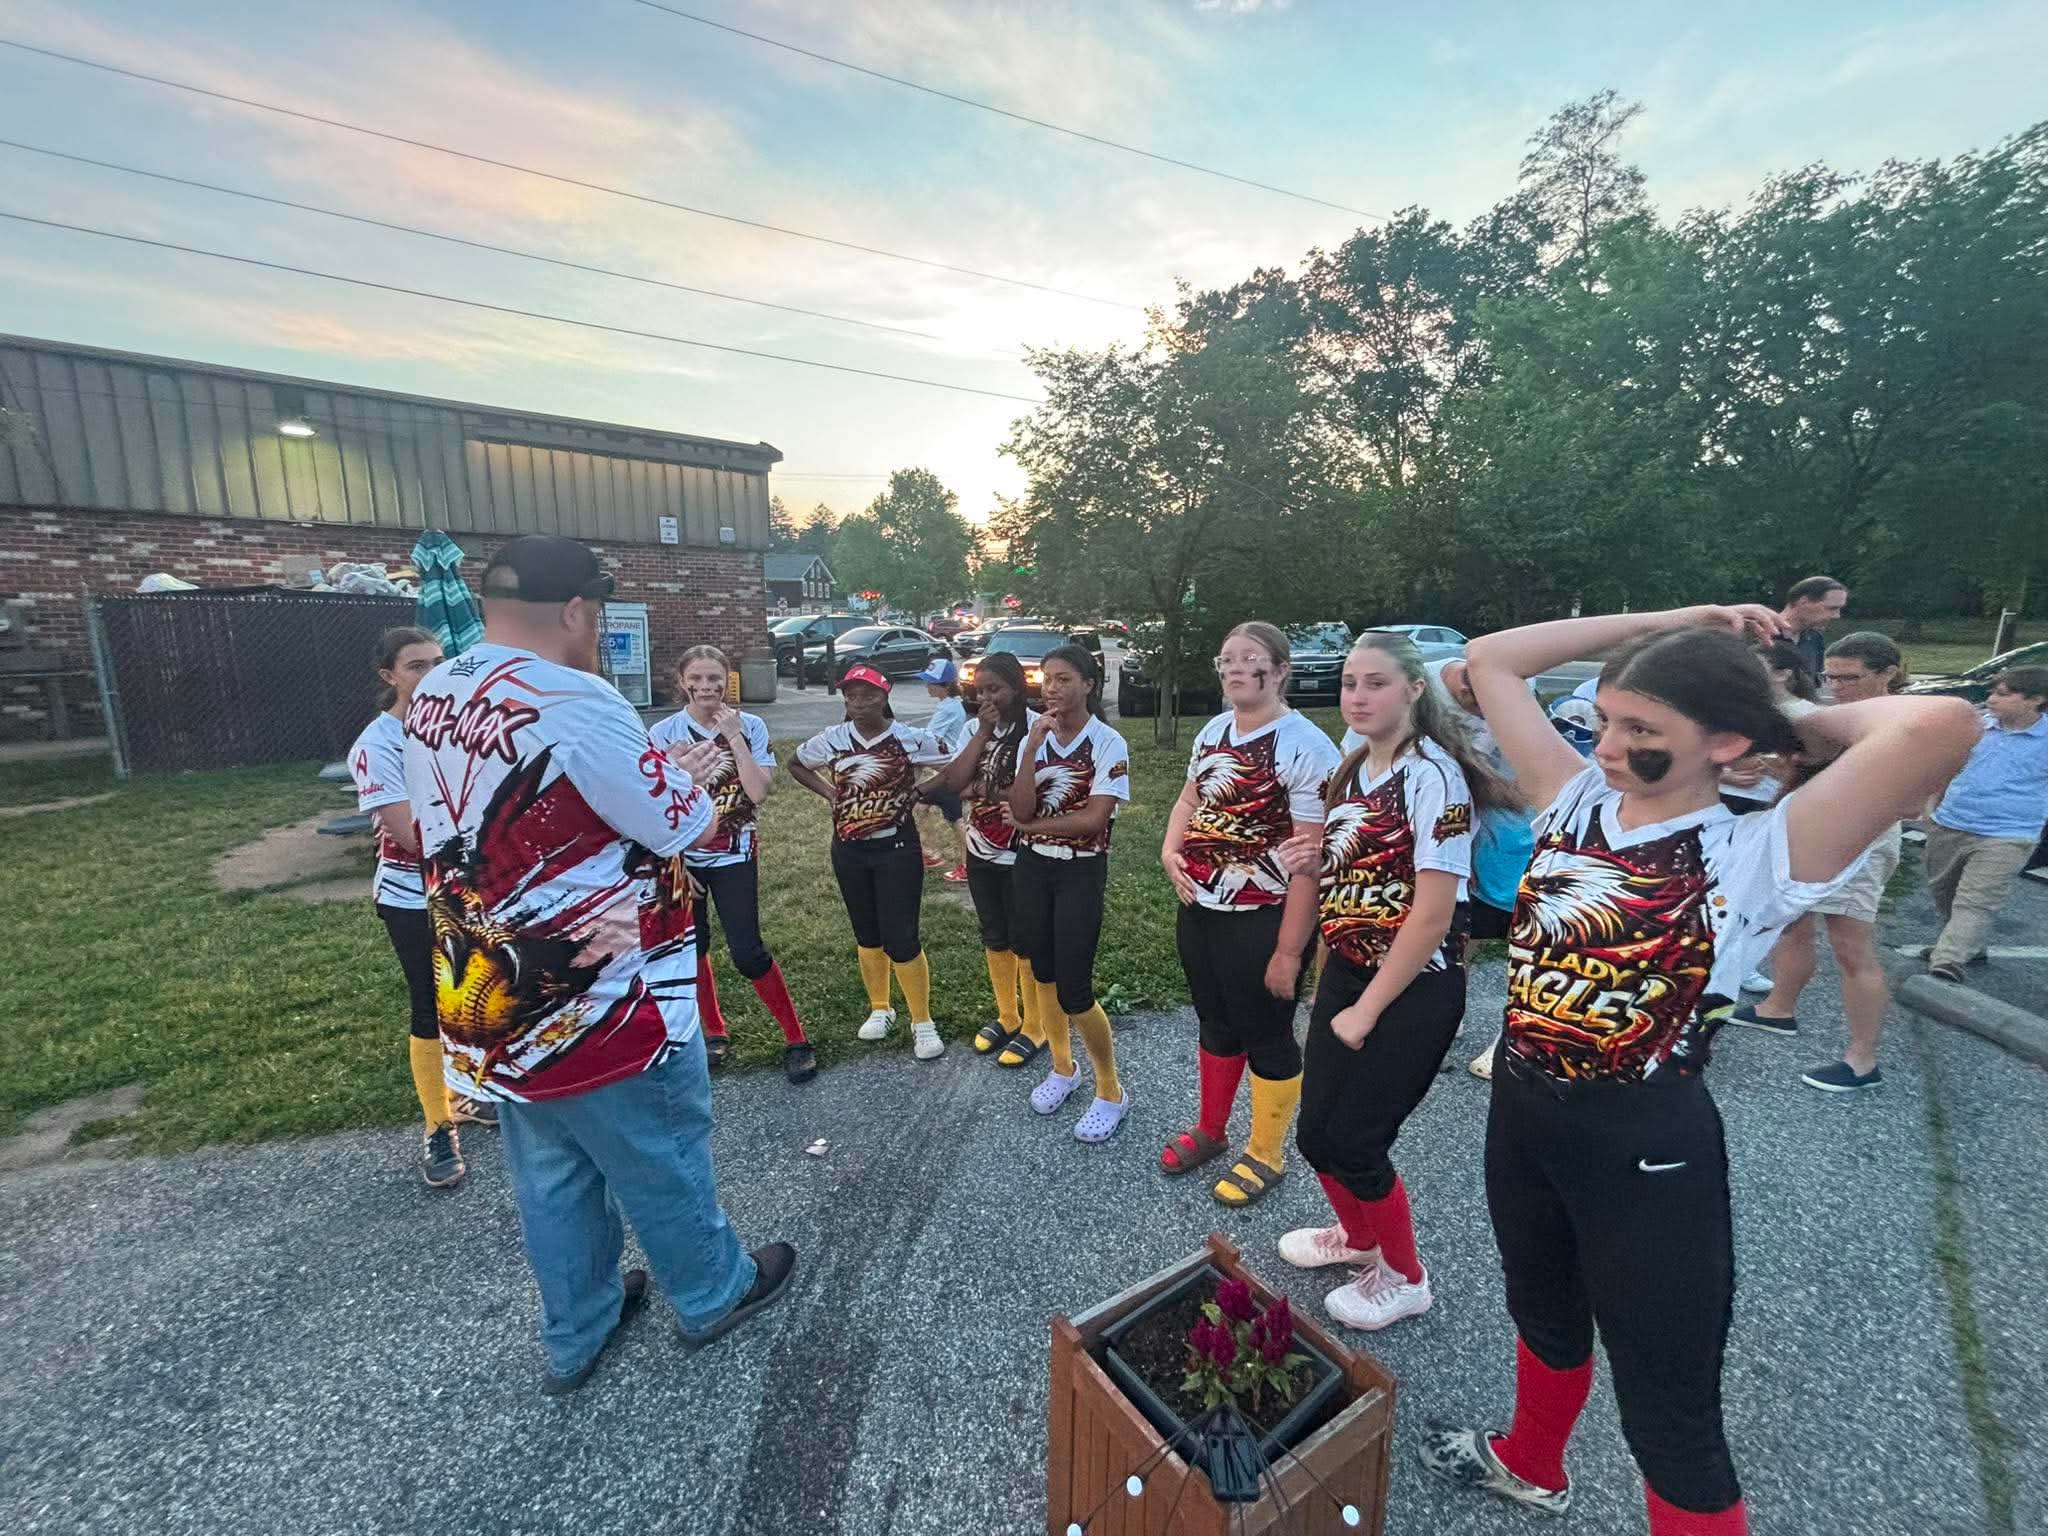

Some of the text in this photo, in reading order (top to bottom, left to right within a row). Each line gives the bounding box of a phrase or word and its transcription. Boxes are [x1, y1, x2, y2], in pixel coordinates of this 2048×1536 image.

[606, 621, 641, 630] ROPANE
[403, 692, 540, 764] ACH-MAX
[356, 749, 368, 778] A
[1538, 947, 1636, 989] LADY
